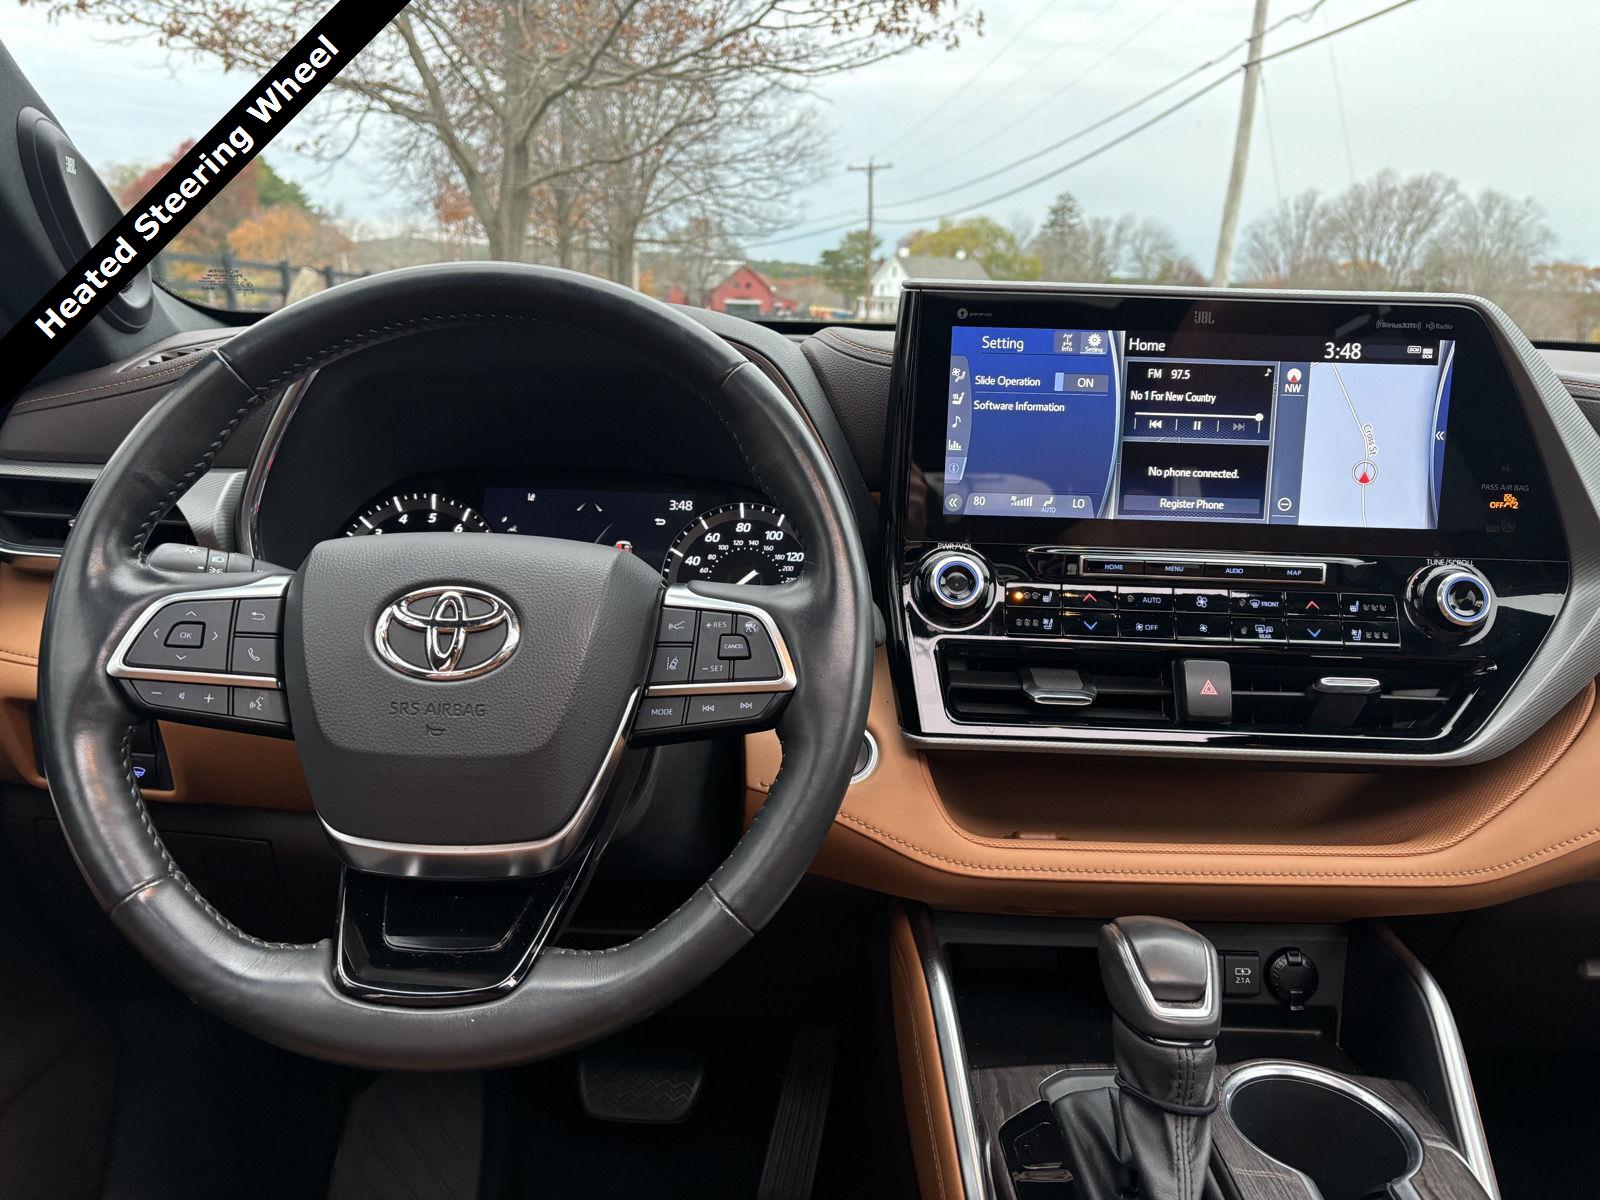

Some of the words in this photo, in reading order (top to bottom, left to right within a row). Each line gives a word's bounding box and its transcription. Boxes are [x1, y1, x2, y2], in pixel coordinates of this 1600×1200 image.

[1194, 310, 1215, 324] JBL
[1435, 322, 1453, 330] Radio
[981, 336, 1024, 352] Setting
[1128, 338, 1166, 353] Home
[1324, 342, 1362, 361] 3:48
[1147, 368, 1162, 379] FM
[1171, 369, 1190, 380] 97.5
[975, 375, 995, 386] Slide
[997, 375, 1041, 388] Operation
[1077, 377, 1094, 389] ON
[1284, 383, 1302, 393] NW
[1130, 390, 1143, 401] No
[1144, 391, 1149, 401] 1
[1150, 391, 1164, 402] For
[1165, 391, 1184, 402] New
[1185, 392, 1216, 404] Country
[973, 400, 1014, 412] Software
[1015, 401, 1065, 412] Information
[1363, 424, 1374, 446] Cross
[1148, 466, 1163, 477] No
[1164, 467, 1191, 479] phone
[1192, 468, 1240, 479] connected.
[1481, 483, 1499, 491] PASS
[1513, 484, 1530, 492] BAG
[669, 499, 694, 511] 3:48
[973, 496, 986, 506] 80
[1072, 498, 1085, 509] LO
[1159, 498, 1195, 510] Register
[1195, 499, 1225, 510] Phone
[1489, 501, 1504, 509] OFF
[398, 513, 408, 525] 4
[427, 512, 438, 524] 5
[453, 523, 463, 533] 6
[735, 522, 752, 533] 80
[704, 532, 721, 543] 60
[764, 530, 784, 541] 100
[684, 555, 701, 566] 40
[707, 553, 717, 561] 80
[786, 551, 805, 562] 120
[1104, 563, 1124, 571] HOME
[1426, 558, 1474, 567] TUNE/SCROLL
[699, 566, 709, 574] 60
[1164, 565, 1184, 573] MENU
[1225, 567, 1244, 575] AUDIO
[1142, 596, 1162, 604] AUTO
[1260, 600, 1280, 608] FRONT
[1144, 623, 1159, 631] OFF
[179, 631, 192, 640] OK
[724, 642, 744, 650] CANCEL
[710, 663, 724, 673] SET
[388, 701, 421, 716] SRS
[423, 702, 486, 717] AIRBAG
[651, 707, 673, 717] MODE
